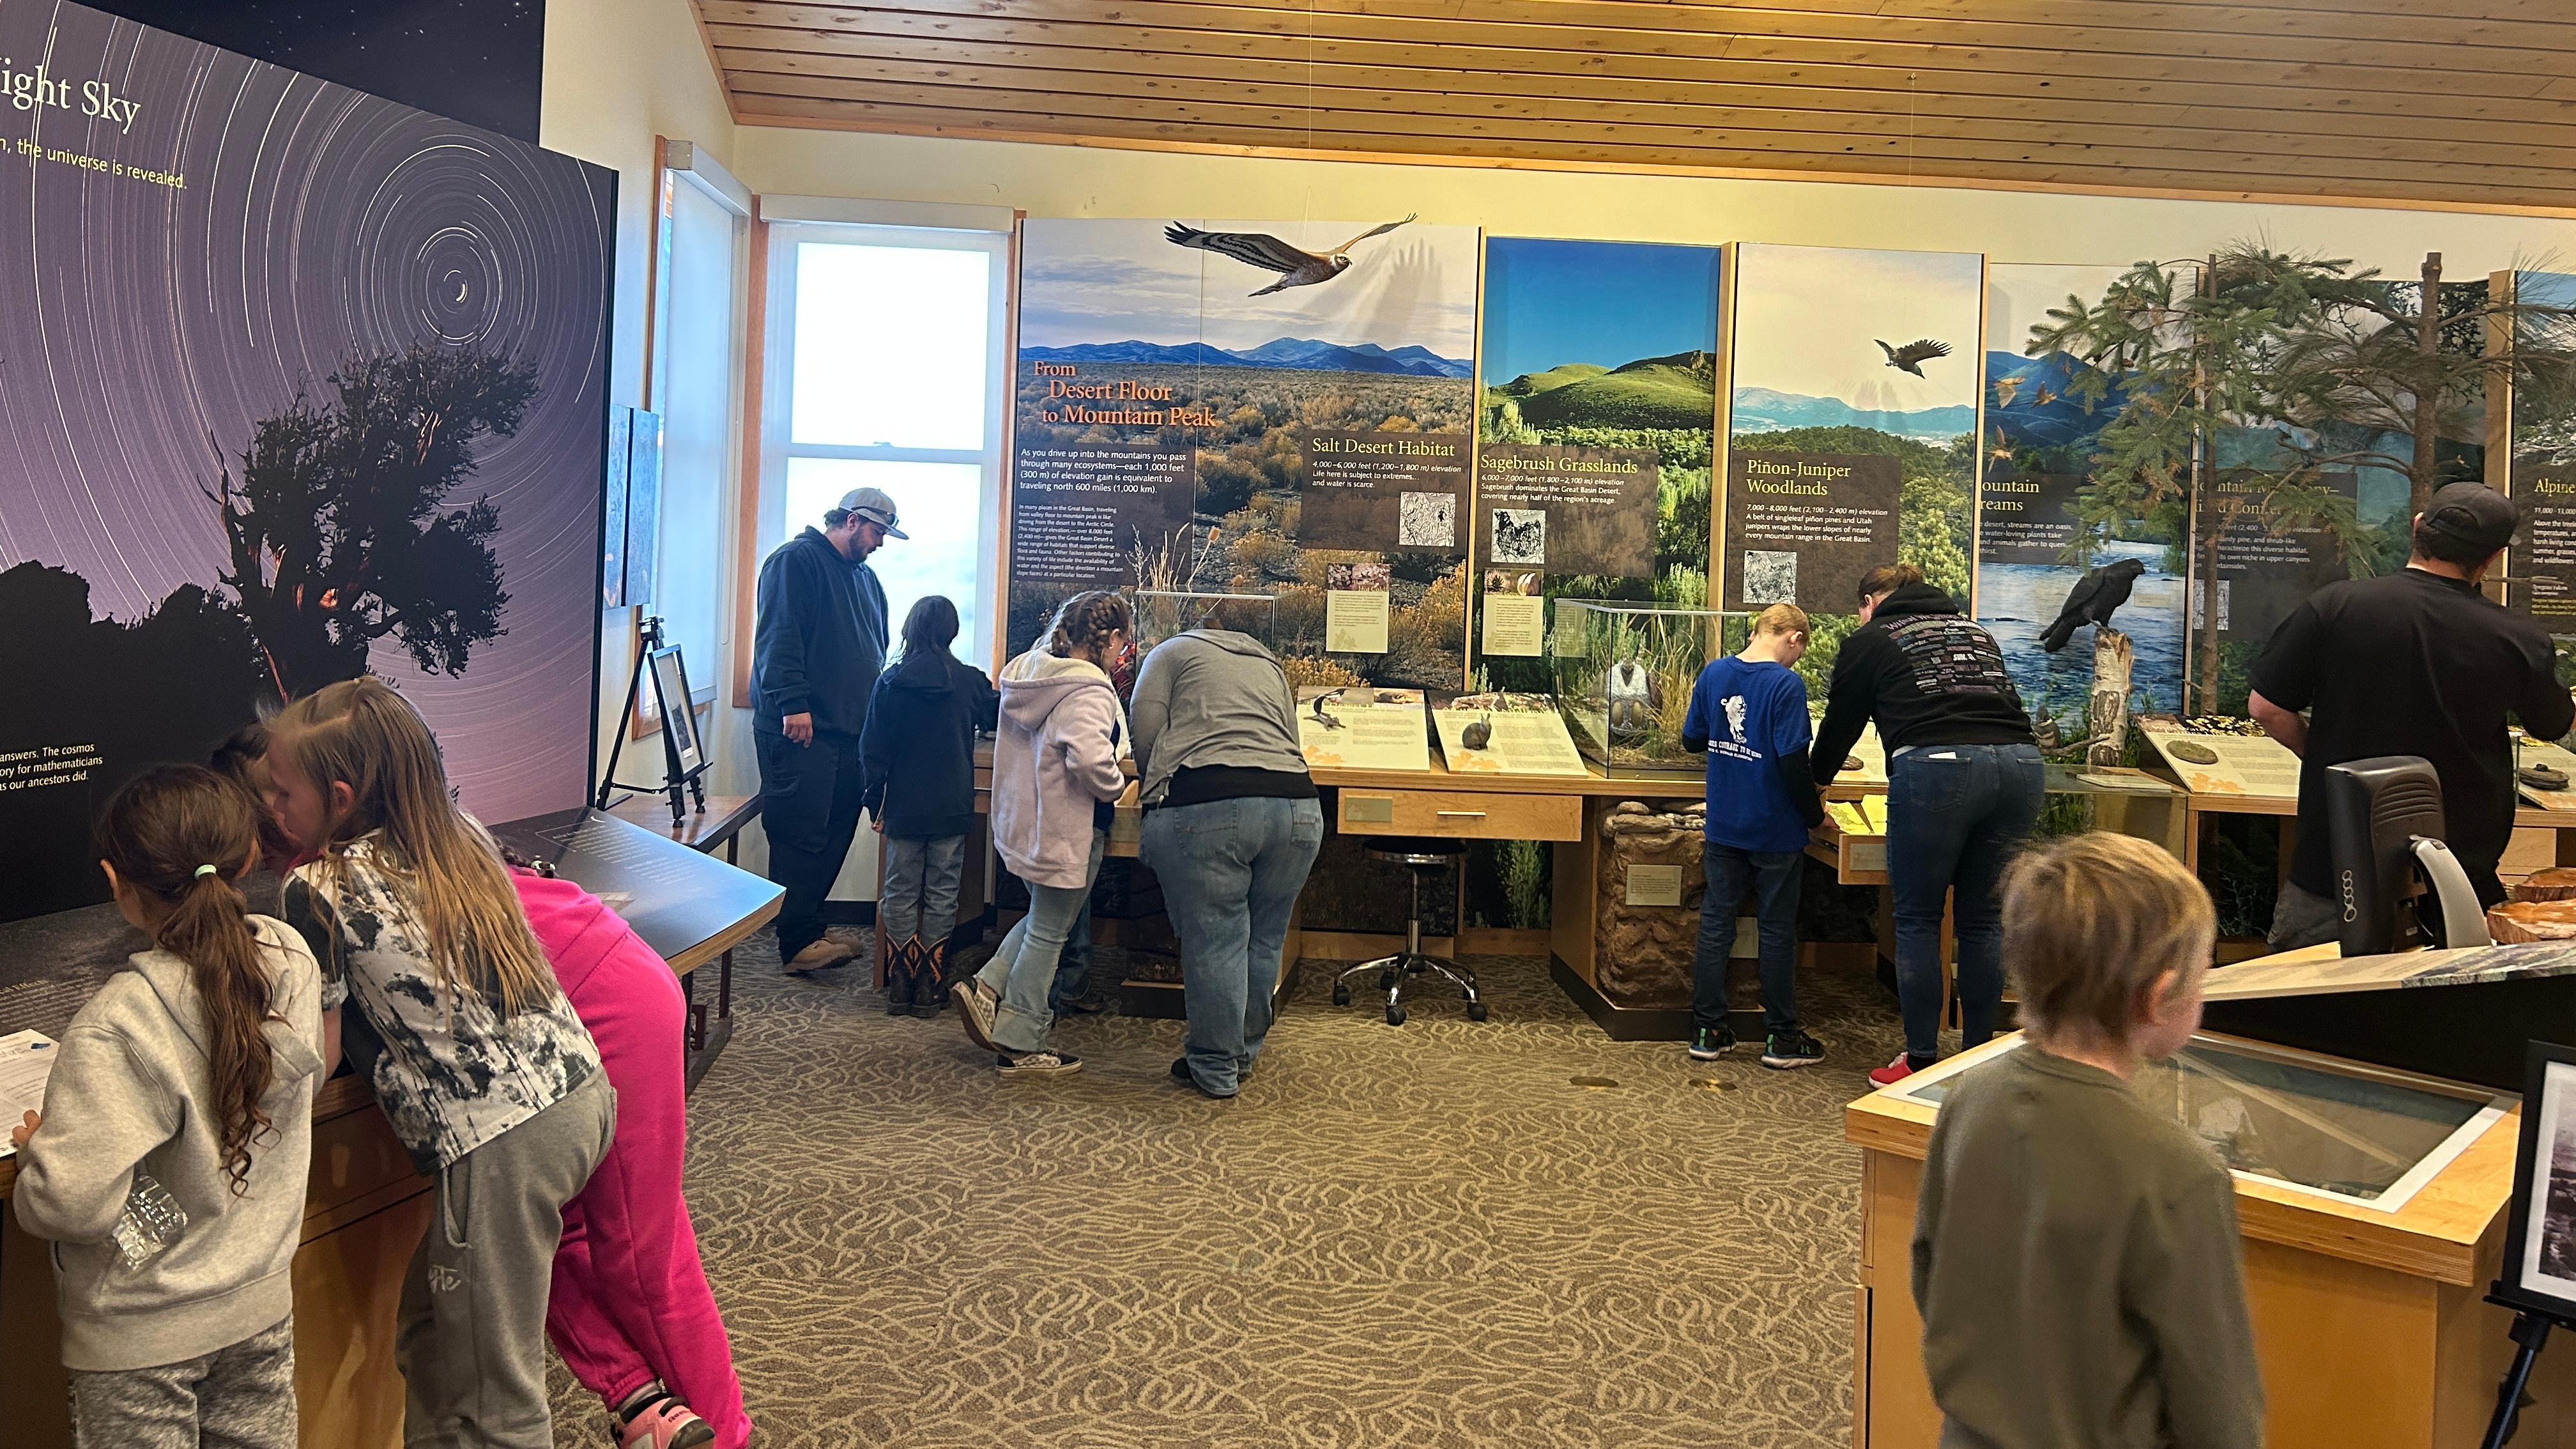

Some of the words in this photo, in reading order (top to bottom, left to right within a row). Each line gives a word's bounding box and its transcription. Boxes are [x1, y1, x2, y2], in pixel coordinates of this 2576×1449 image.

[0, 57, 70, 110] ight
[81, 80, 141, 135] Sky
[17, 138, 42, 157] the
[47, 148, 107, 172] universe
[112, 159, 122, 175] is
[127, 165, 187, 189] revealed.
[1034, 361, 1076, 376] From
[1050, 379, 1112, 399] Desert
[1119, 381, 1172, 401] Floor
[1043, 410, 1058, 422] to
[1064, 404, 1164, 425] Mountain
[1169, 407, 1216, 427] Peak
[1312, 438, 1340, 452] Salt
[1344, 439, 1393, 454] Desert
[1398, 440, 1455, 456] Habitat
[1021, 447, 1031, 456] As
[1031, 450, 1046, 458] you
[1047, 448, 1066, 457] drive
[1068, 451, 1078, 459] up
[1096, 450, 1109, 458] the
[1110, 450, 1151, 459] mountains
[1152, 454, 1167, 462] you
[1169, 454, 1186, 463] pass
[1021, 458, 1050, 470] through
[1051, 461, 1073, 470] many
[1144, 462, 1167, 472] 1,000
[1169, 463, 1184, 471] feet
[1480, 454, 1554, 473] Sagebrush
[1559, 457, 1638, 473] Grasslands
[1747, 459, 1851, 480] Piñon-Juniper
[1021, 469, 1038, 480] (300
[1039, 470, 1050, 480] m)
[1050, 470, 1060, 479] of
[1061, 470, 1095, 480] elevation
[1096, 472, 1113, 482] gain
[1122, 472, 1163, 484] equivalent
[1163, 474, 1173, 482] to
[1349, 470, 1372, 480] subject
[1020, 480, 1052, 491] traveling
[1053, 481, 1073, 490] north
[1075, 482, 1091, 491] 600
[1092, 482, 1112, 491] miles
[1113, 483, 1138, 494] (1,000
[1140, 484, 1157, 495] km).
[1481, 482, 1514, 492] Sagebrush
[1746, 479, 1828, 496] Woodlands
[1981, 479, 2039, 493] ountain
[2534, 478, 2575, 496] Alpine
[1481, 492, 1508, 501] covering
[1509, 493, 1529, 502] nearly
[1980, 500, 2023, 511] reams
[1774, 514, 1804, 523] singleleaf
[1824, 516, 1841, 525] pines
[1984, 520, 2005, 528] desert,
[1745, 522, 1770, 531] junipers
[1822, 525, 1843, 534] slopes
[1851, 526, 1872, 535] nearly
[1984, 529, 2025, 539] water-loving
[2026, 530, 2046, 539] plants
[2017, 539, 2039, 548] gather
[2237, 535, 2252, 544] pine,
[2216, 543, 2250, 551] haracterize
[2285, 546, 2308, 554] habitat,
[0, 749, 39, 762] answers.
[42, 746, 59, 757] The
[61, 744, 95, 755] cosmos
[1719, 741, 1738, 752] COURAGE
[17, 763, 31, 774] for
[33, 756, 103, 772] mathematicians
[10, 780, 26, 789] our
[27, 774, 70, 787] ancestors
[72, 770, 89, 781] did.
